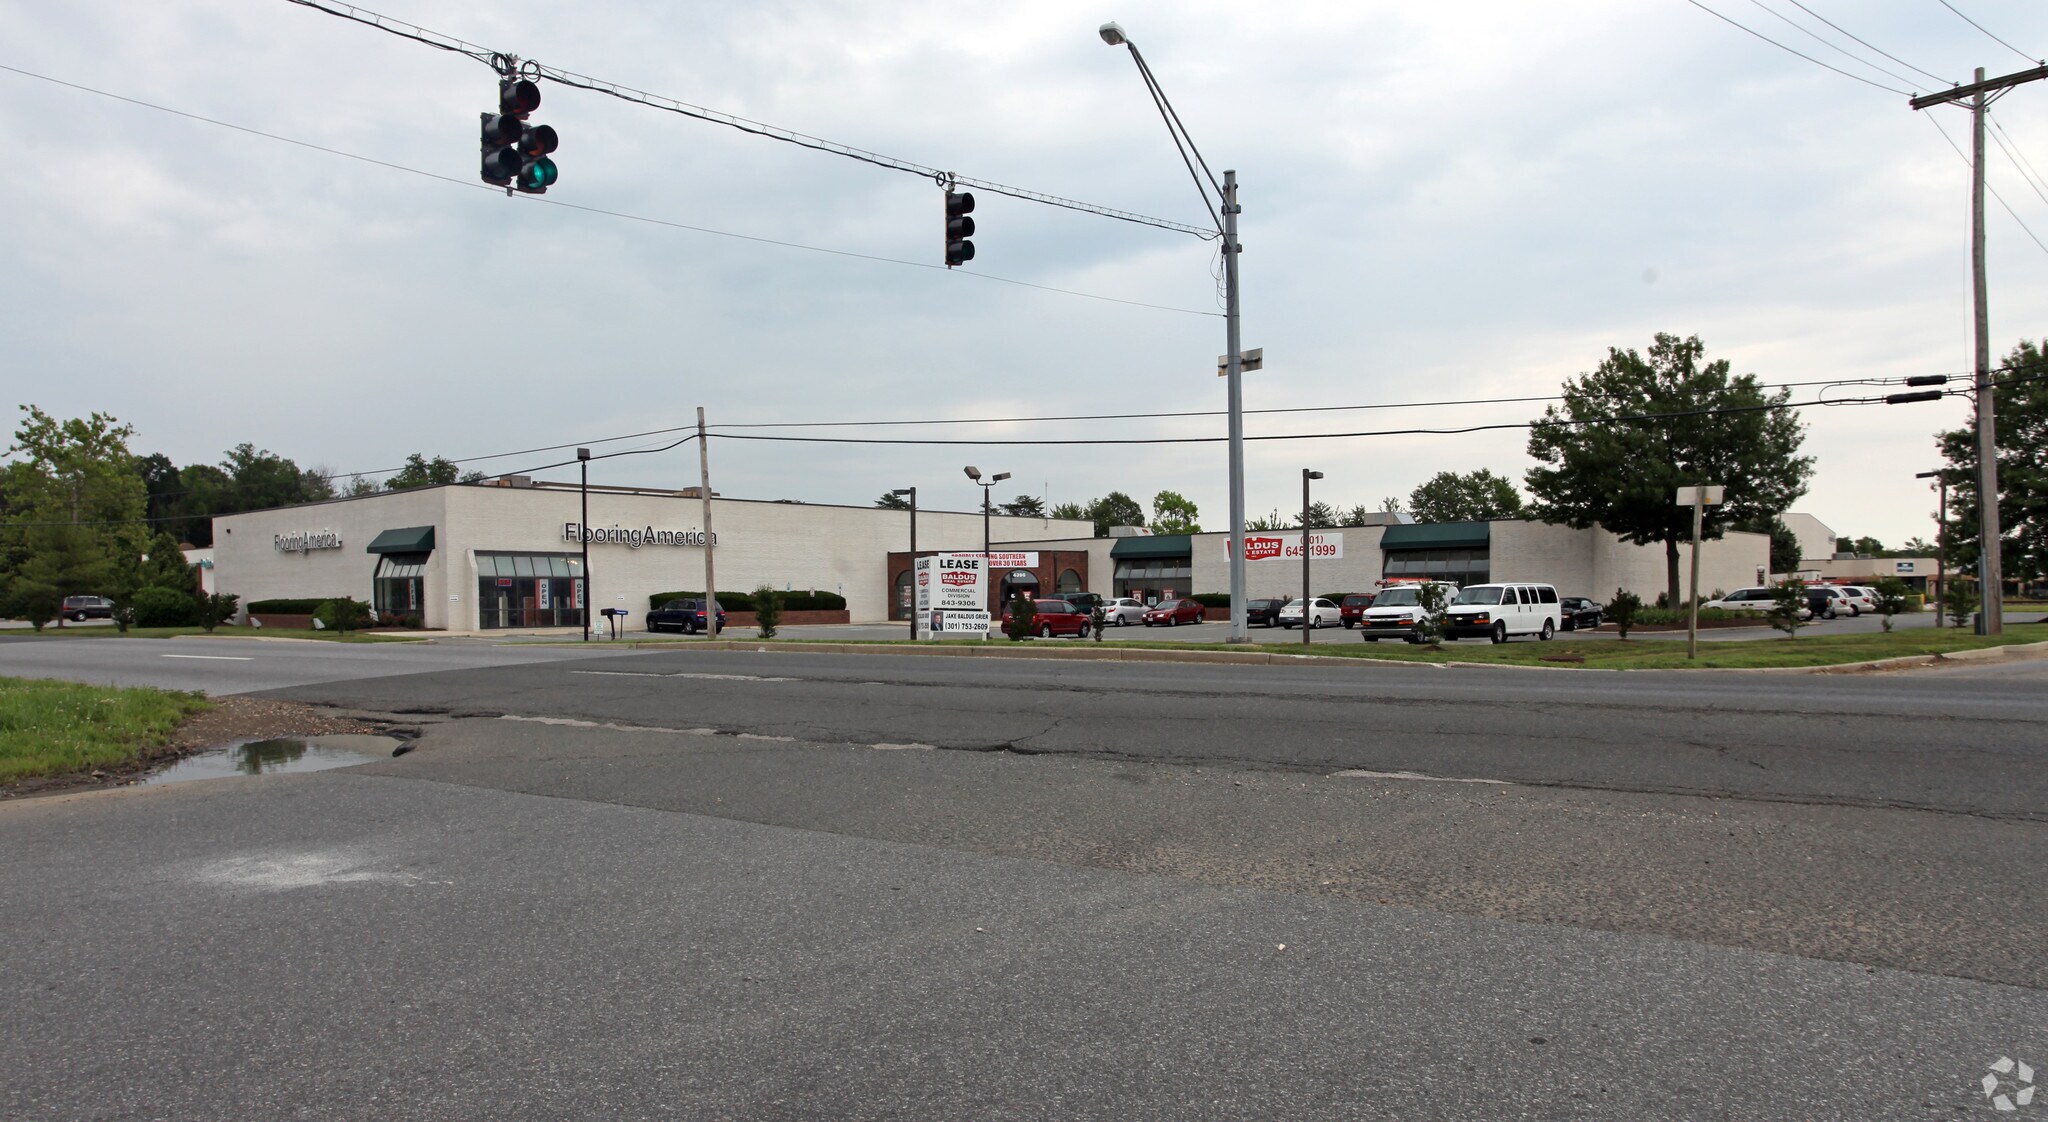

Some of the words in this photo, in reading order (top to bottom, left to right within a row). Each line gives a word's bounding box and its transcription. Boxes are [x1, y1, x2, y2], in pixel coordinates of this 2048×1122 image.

[274, 529, 337, 553] FlooringAmerica
[1300, 535, 1324, 545] (01)
[917, 559, 930, 570] LEASE
[940, 559, 979, 569] LEASE
[945, 622, 960, 630] (301)
[961, 622, 988, 630] 753-2609
